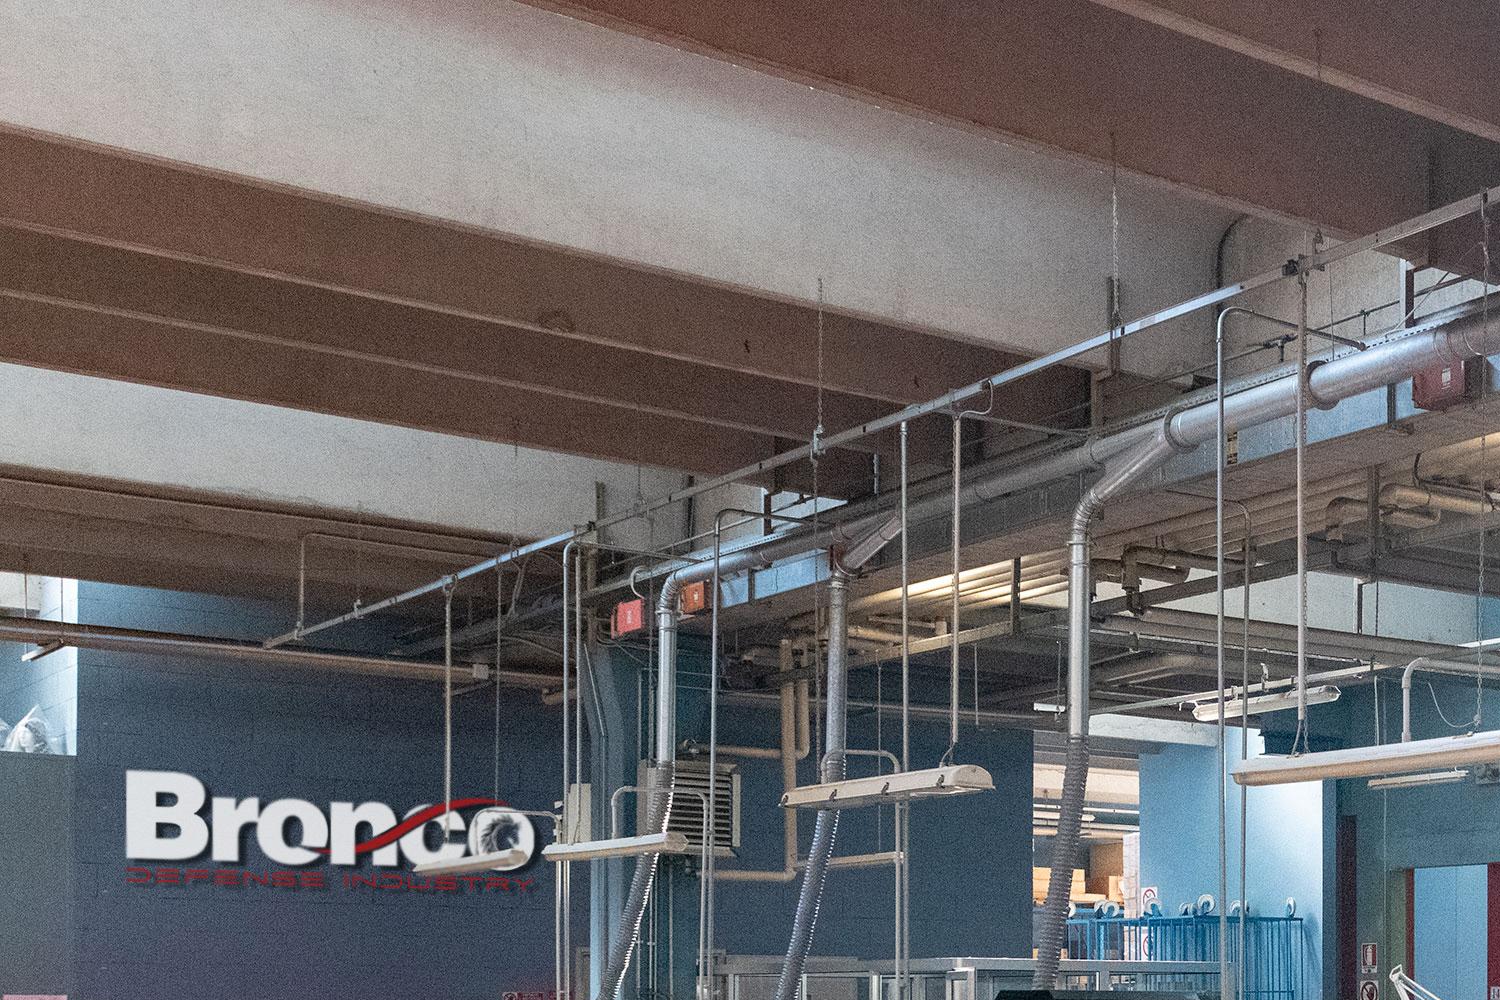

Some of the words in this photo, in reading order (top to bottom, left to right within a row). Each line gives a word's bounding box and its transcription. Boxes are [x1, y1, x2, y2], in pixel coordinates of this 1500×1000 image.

[126, 769, 535, 871] Bronco
[126, 866, 325, 888] DEFENSE
[343, 873, 536, 893] INDUSTRY
